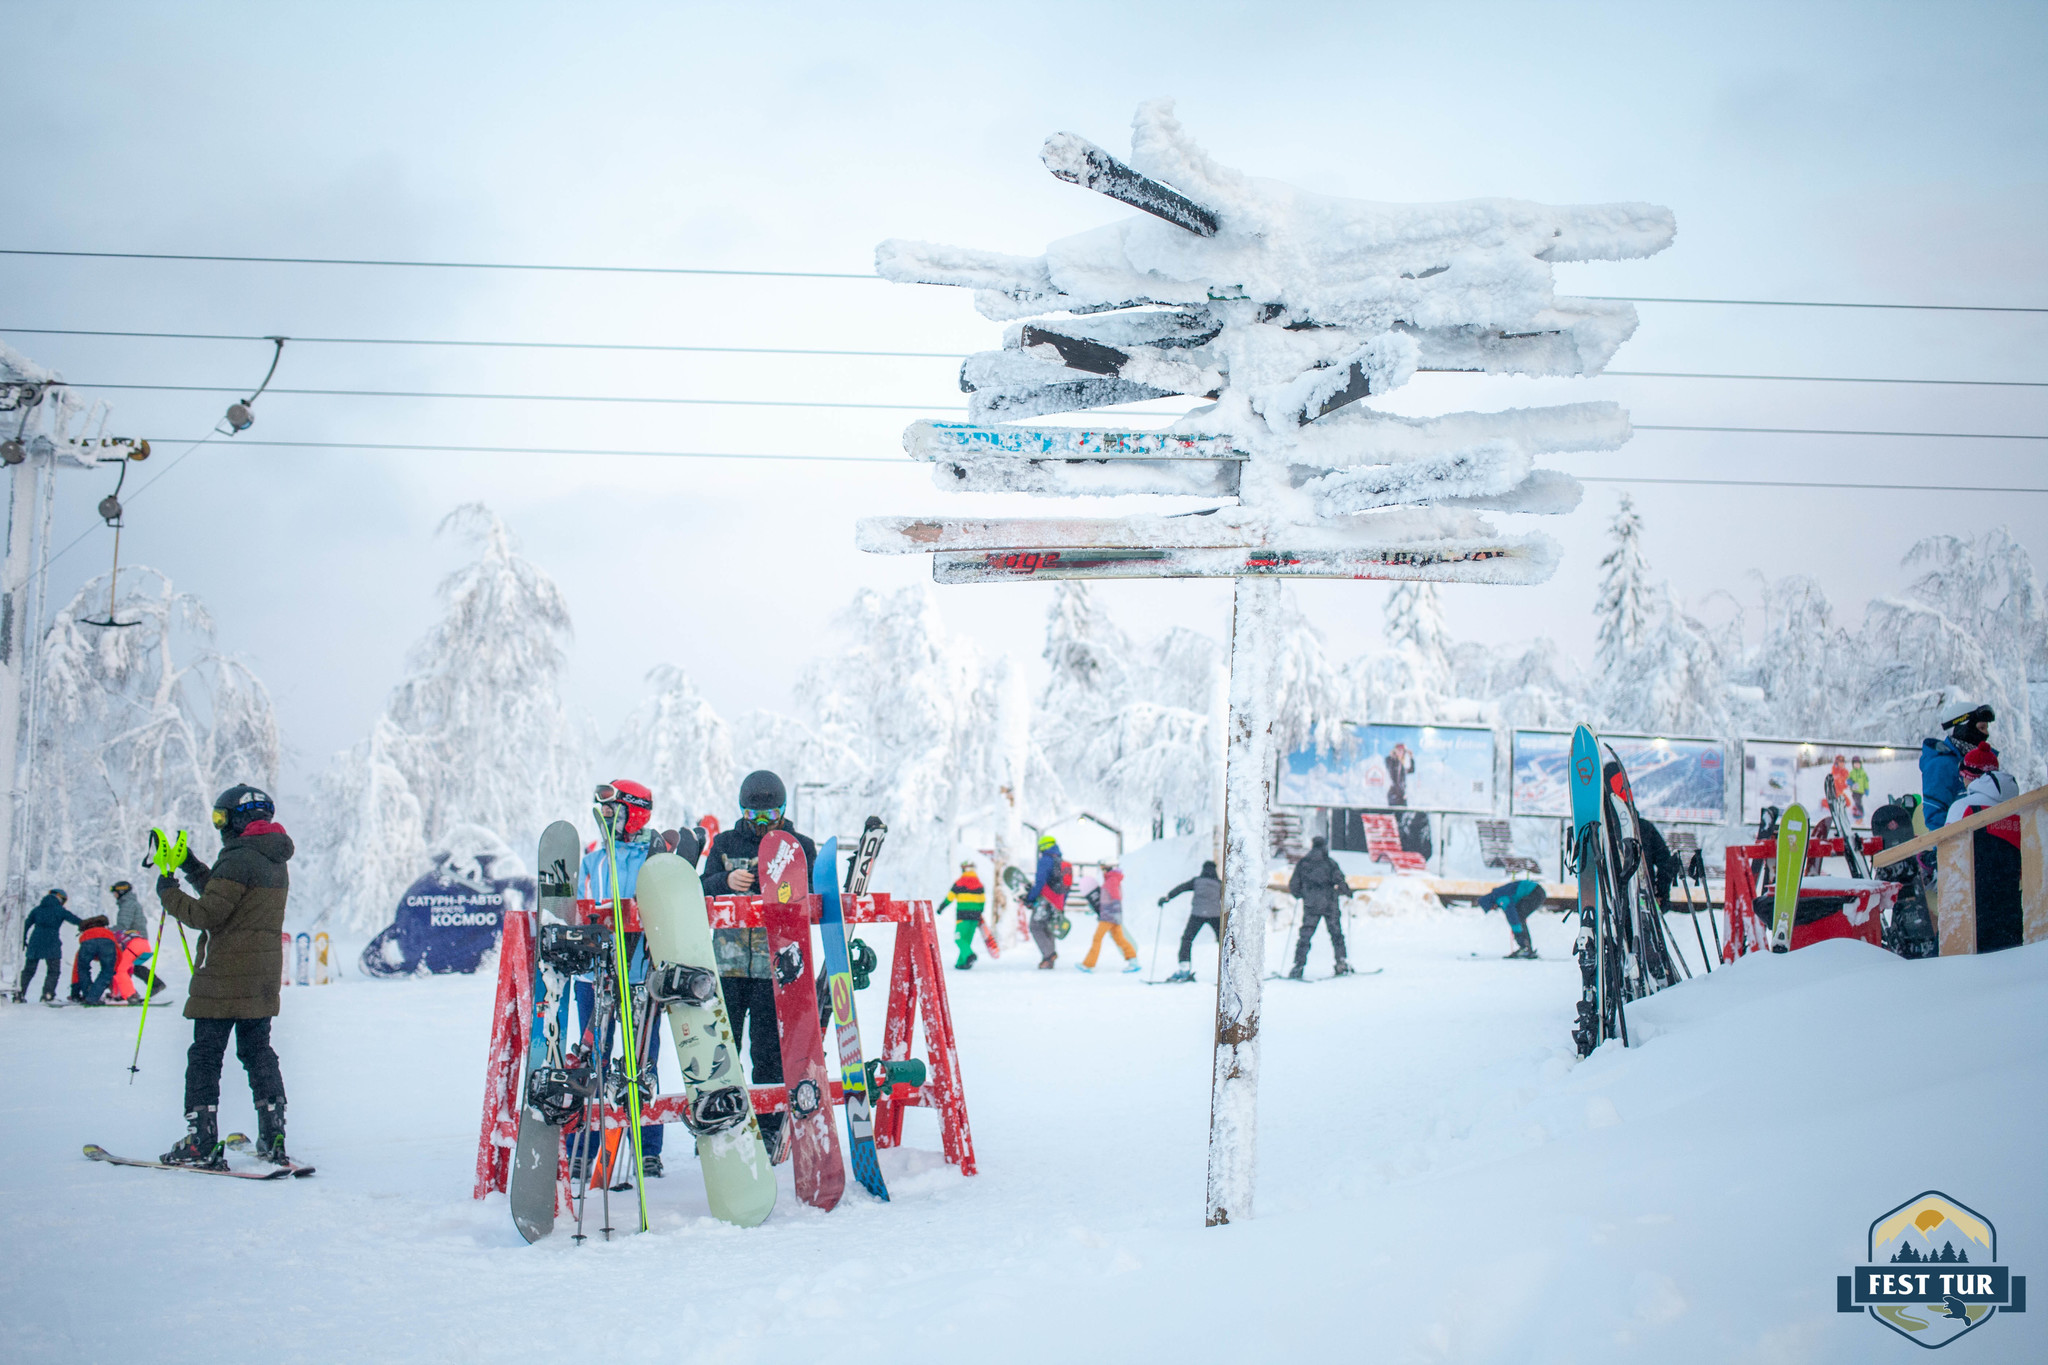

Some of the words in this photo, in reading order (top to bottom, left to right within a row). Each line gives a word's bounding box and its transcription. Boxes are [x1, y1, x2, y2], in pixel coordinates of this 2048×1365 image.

[854, 836, 878, 896] EAD
[407, 894, 503, 907] САТУРН-Р-АВТО
[431, 912, 498, 927] КОСМОС
